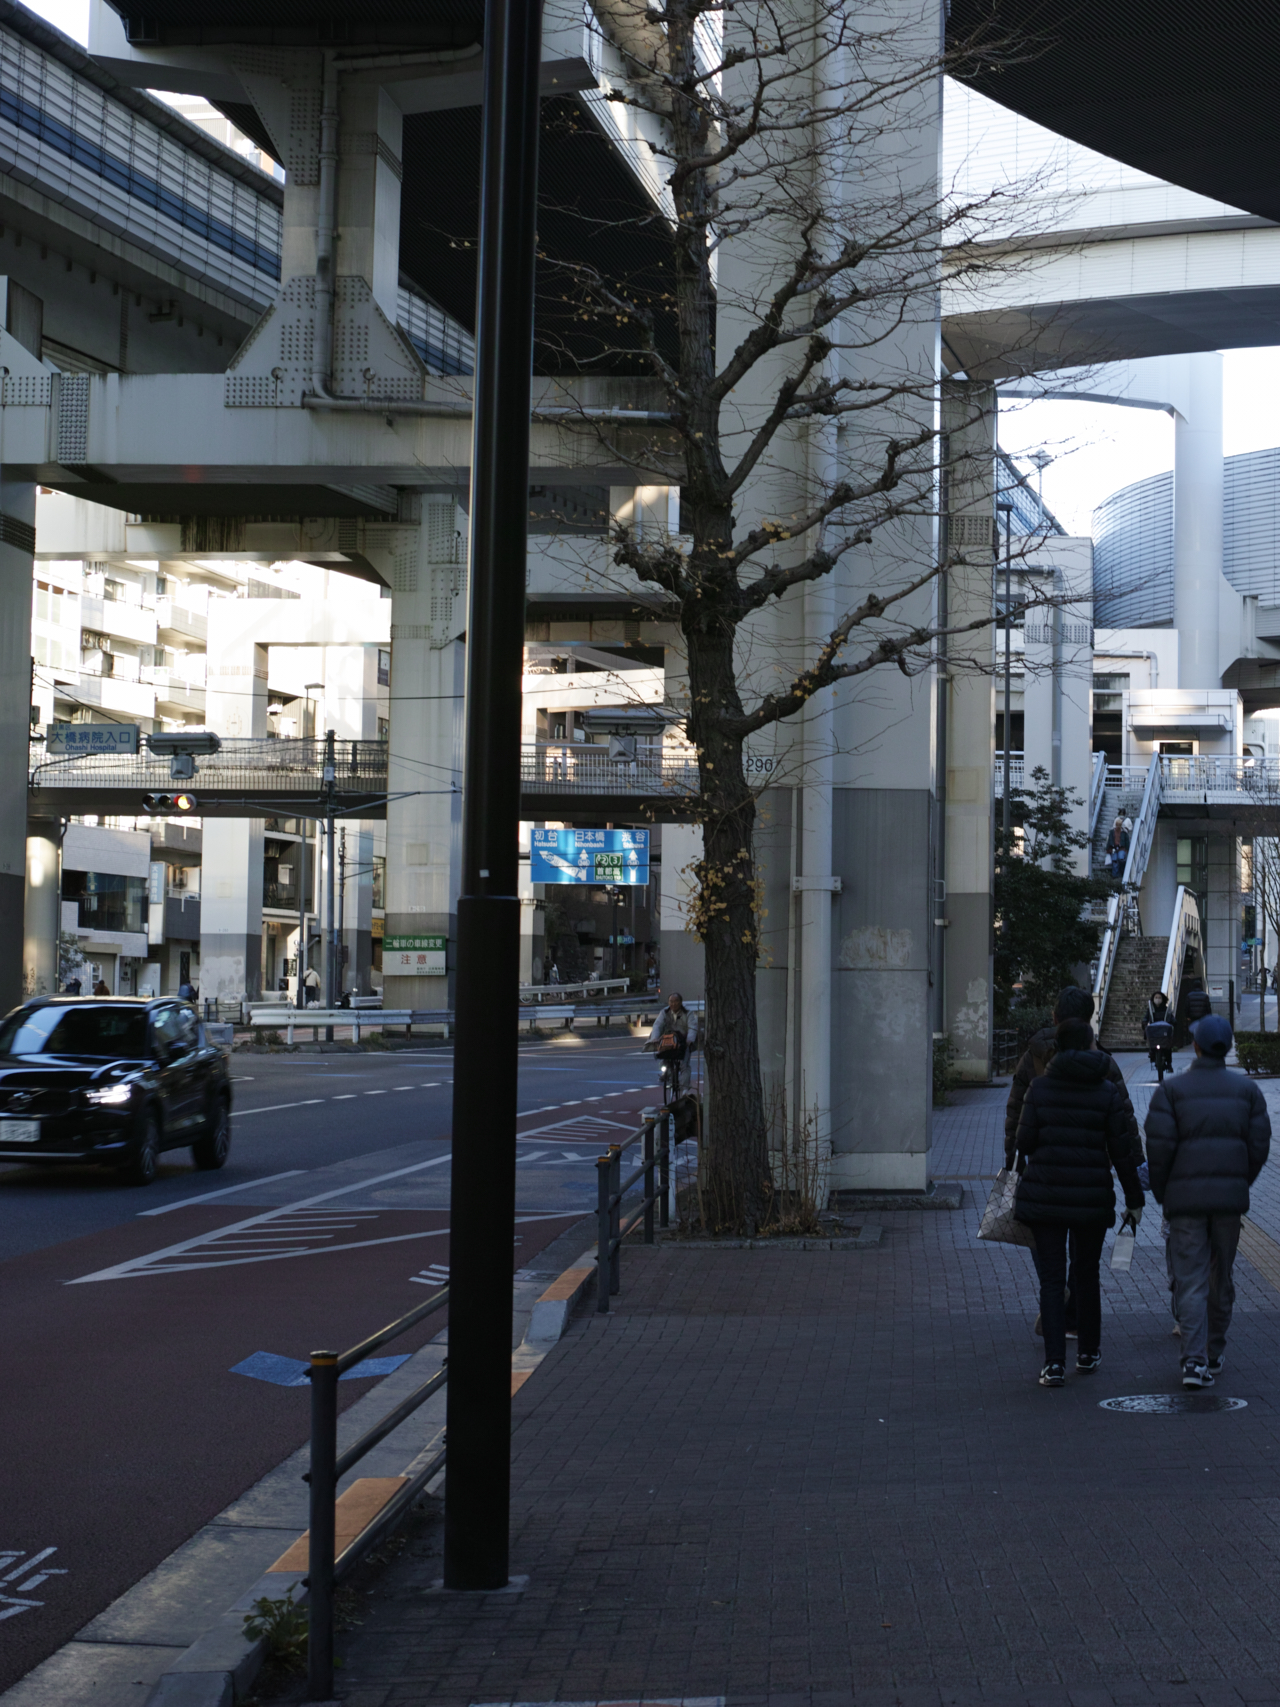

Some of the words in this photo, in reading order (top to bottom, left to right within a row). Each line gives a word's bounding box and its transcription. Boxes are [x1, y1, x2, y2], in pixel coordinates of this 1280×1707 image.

[51, 731, 130, 744] 大橋病院入口
[90, 744, 117, 752] Hospital
[534, 831, 558, 841] 初台
[575, 831, 605, 842] 日本橋
[621, 831, 646, 842] 渋谷
[385, 938, 443, 949] 二輪車の車線変更
[401, 954, 427, 965] 注意
